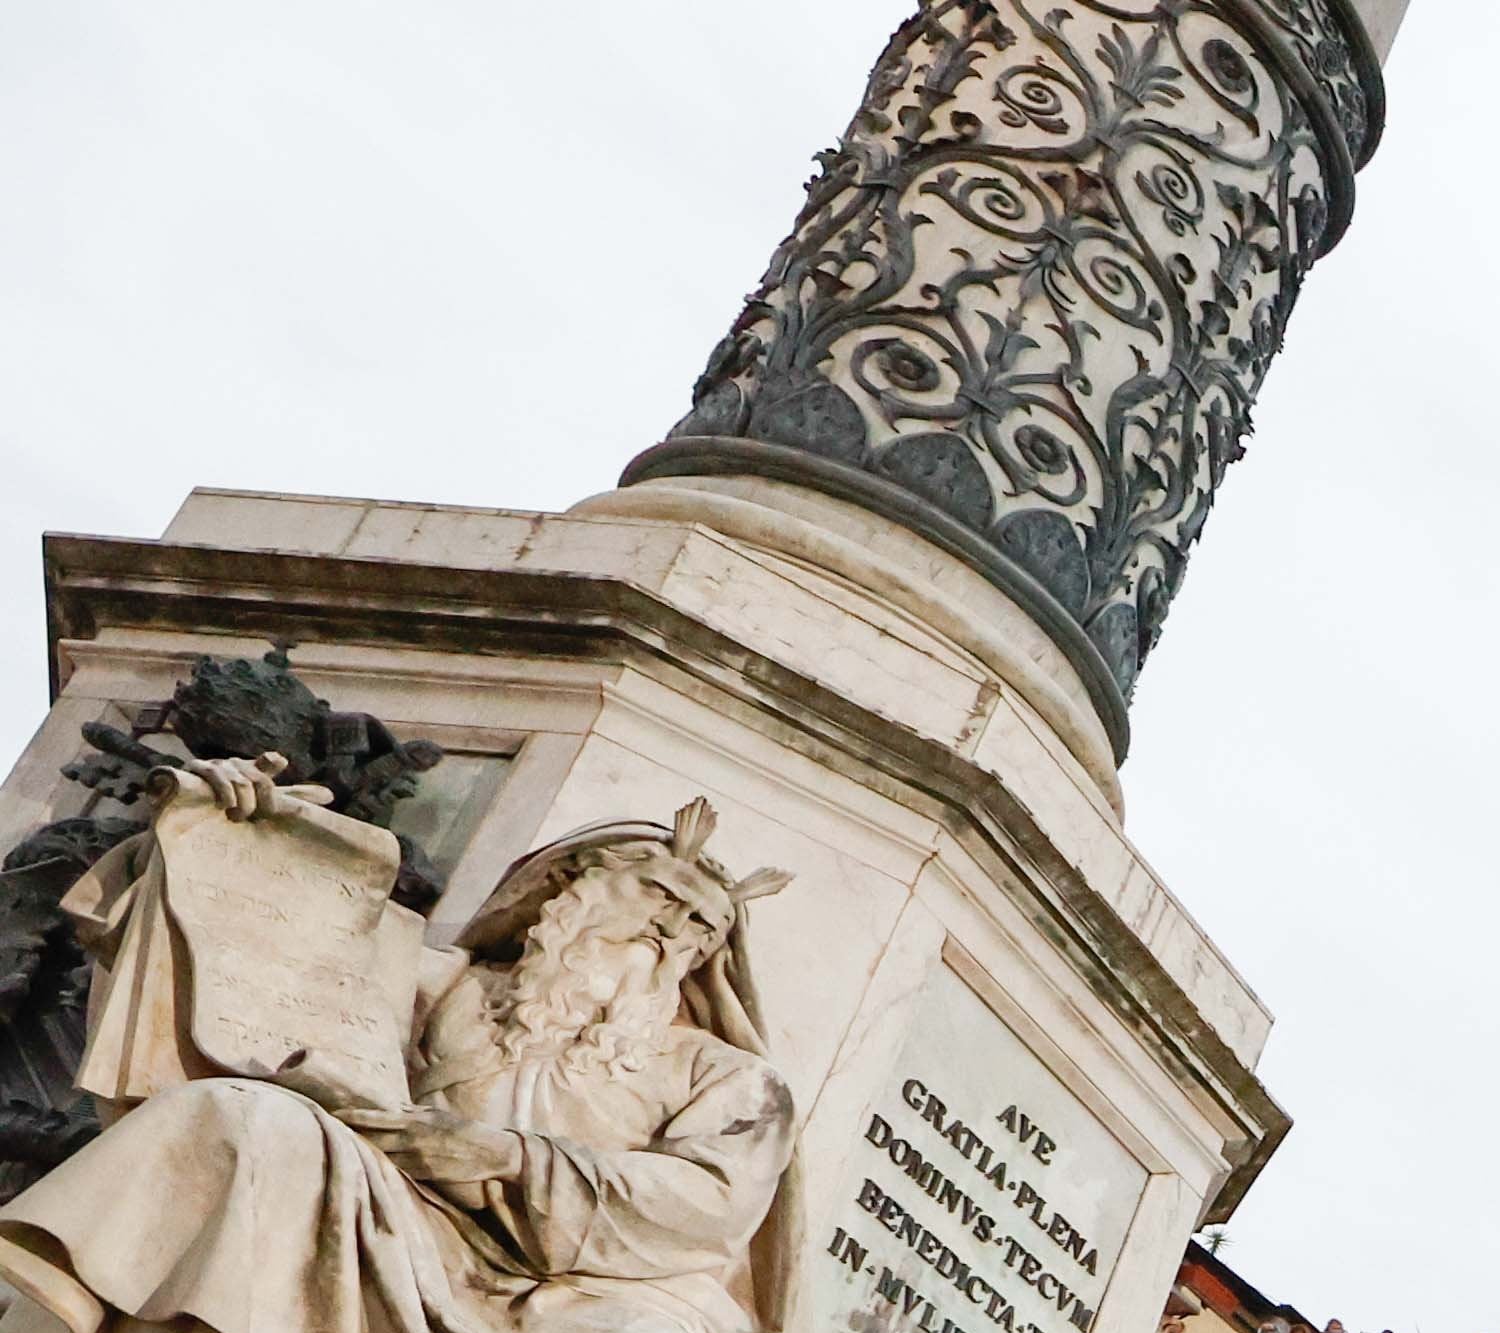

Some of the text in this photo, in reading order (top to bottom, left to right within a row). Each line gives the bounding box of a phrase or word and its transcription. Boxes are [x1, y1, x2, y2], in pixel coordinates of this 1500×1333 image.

[902, 1079, 1098, 1276] GRATIA PLENA
[996, 1104, 1057, 1165] AVE
[827, 1227, 869, 1272] IN
[855, 1178, 1016, 1333] BENEDICTA
[864, 1113, 1095, 1333] DOMINVS TECVM
